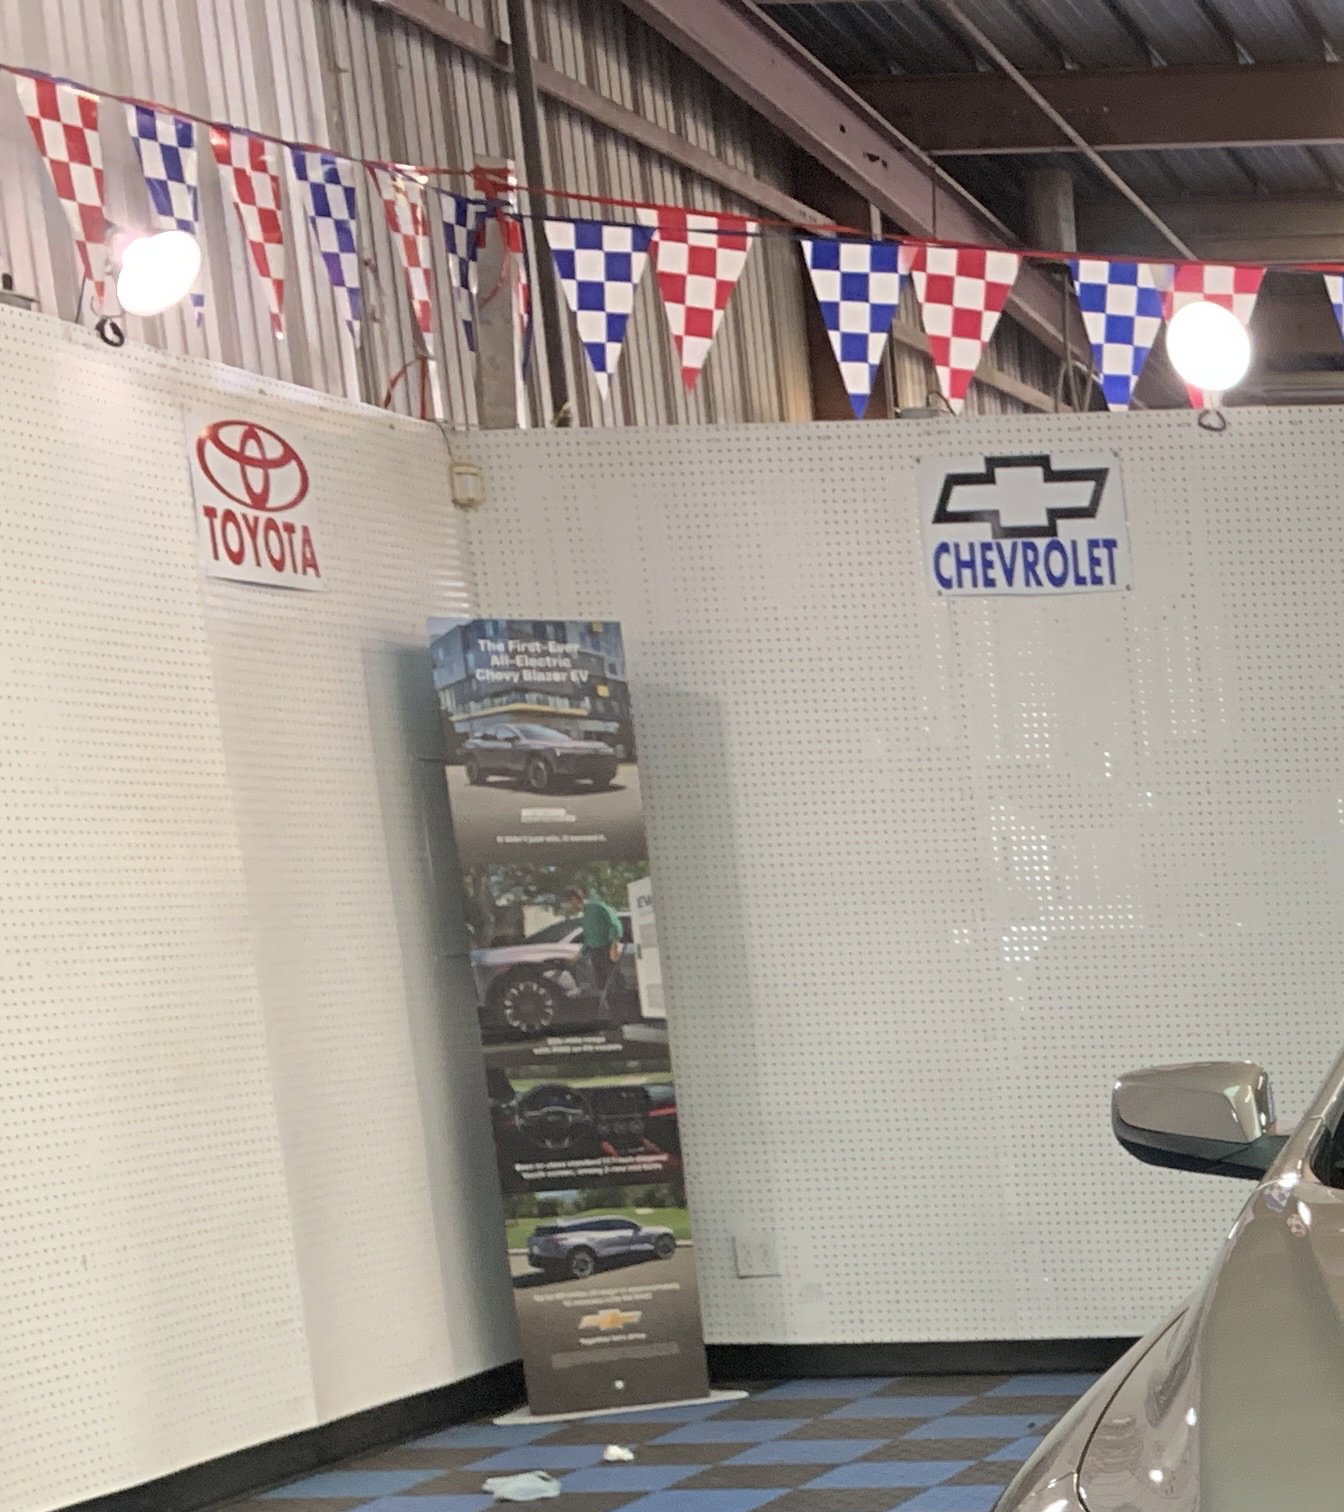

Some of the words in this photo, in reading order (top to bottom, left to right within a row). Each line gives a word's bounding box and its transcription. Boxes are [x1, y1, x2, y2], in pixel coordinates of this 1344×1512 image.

[203, 505, 321, 578] TOYOTA
[933, 538, 1118, 590] CHEVROLET
[478, 639, 504, 652] The
[508, 639, 580, 654] First-Ever
[490, 655, 572, 668] All-Electric
[476, 668, 520, 683] Chevy
[522, 669, 568, 682] Blazer
[570, 669, 589, 683] EV
